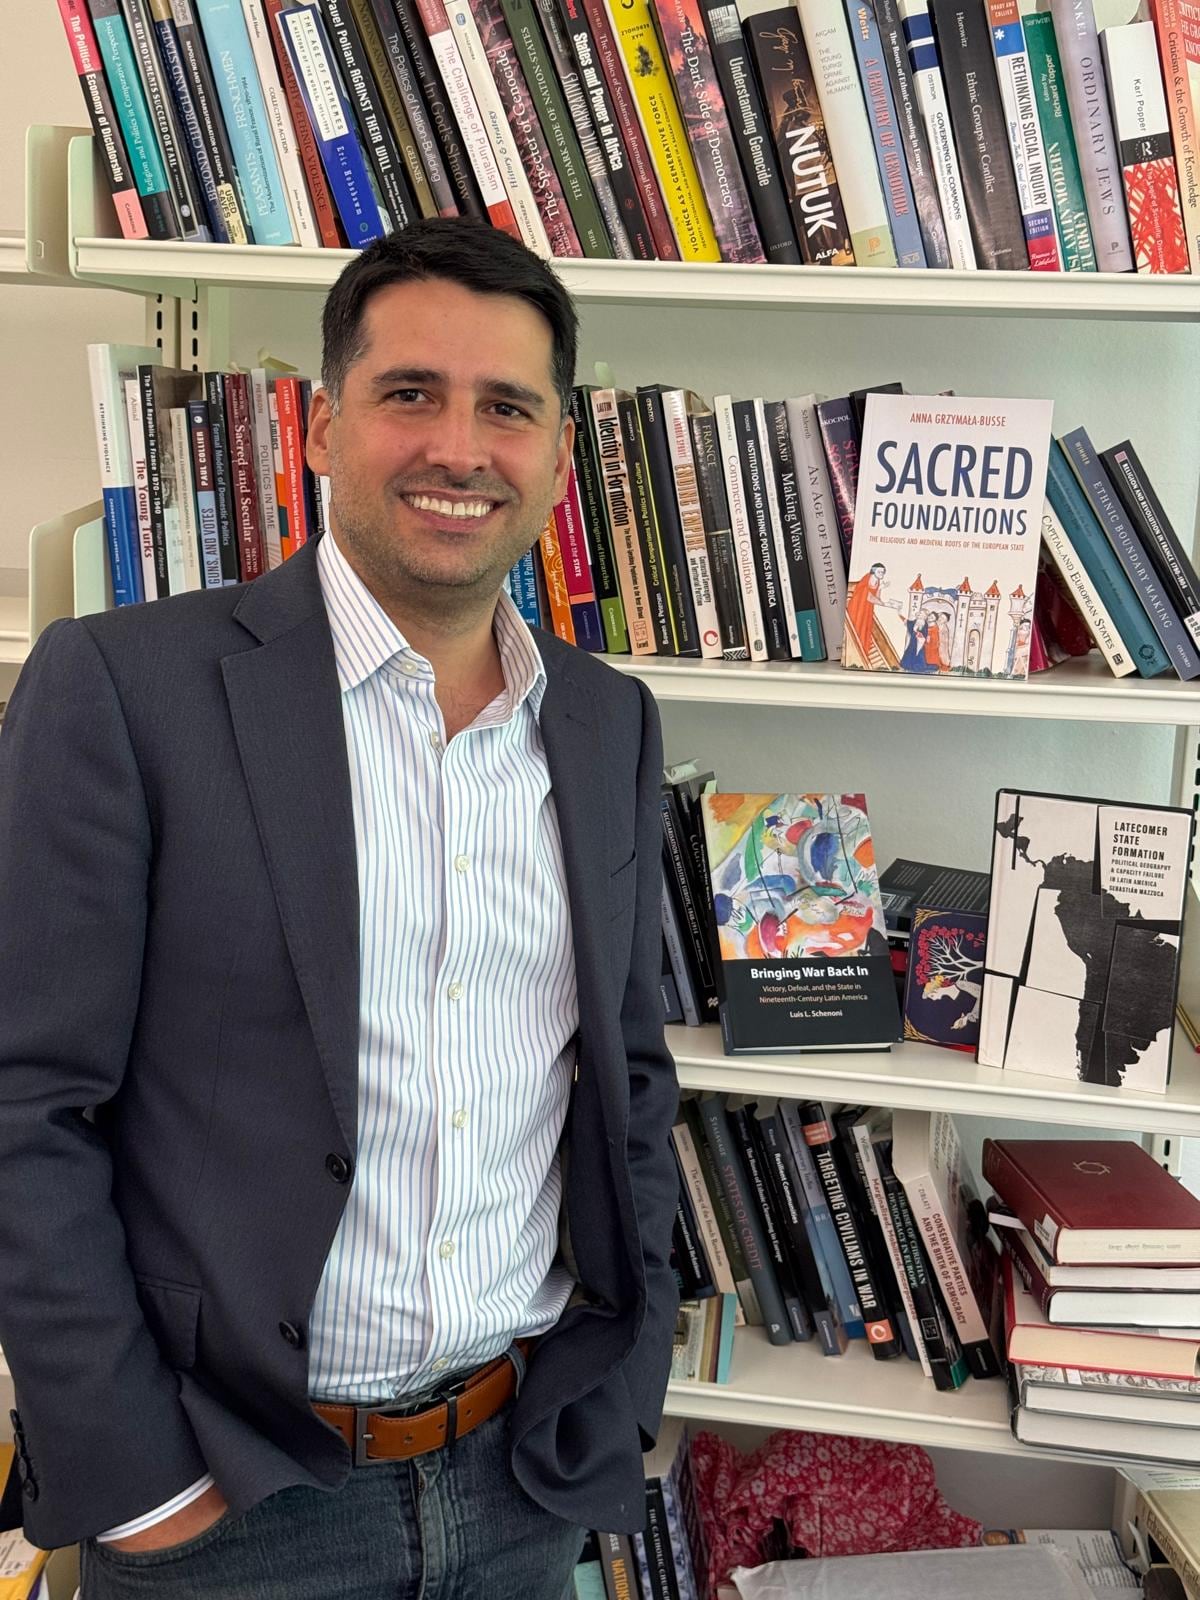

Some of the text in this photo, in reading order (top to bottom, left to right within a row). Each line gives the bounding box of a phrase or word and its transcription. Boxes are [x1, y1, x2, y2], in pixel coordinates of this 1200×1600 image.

[858, 8, 869, 40] Weitz
[70, 15, 123, 182] The Political Economy of Dictatorship
[162, 24, 218, 201] BEYOND CHURCH AND STATE
[388, 33, 441, 182] The Politics of Nation-Building
[444, 43, 498, 191] The Challenge of Pluralism
[521, 27, 582, 200] THE DARK SIDE OF NATION-STATES
[573, 32, 623, 171] States and Power in Africa
[729, 57, 772, 186] Understanding Genocide
[1134, 78, 1146, 131] Karl Popper
[493, 49, 560, 220] The Specter of Genocide
[966, 72, 995, 193] Ethnic Groups in Conflict
[1011, 56, 1047, 205] RETHINKING SOCIAL INQUIRY
[1081, 57, 1113, 215] ORDINARY JEWS
[785, 125, 837, 237] NUTUK
[816, 248, 840, 260] ALFA
[235, 425, 248, 465] Sacred
[598, 417, 621, 459] Identity
[775, 414, 788, 461] WEYLAND
[910, 413, 932, 424] ANNA
[196, 431, 208, 485] PAUL COLLIER
[605, 461, 624, 471] in
[703, 425, 717, 467] FRANCE
[875, 440, 1033, 500] SACRED
[1075, 441, 1090, 464] WIMMER
[238, 470, 250, 493] and
[260, 445, 274, 528] POLITICS IN TIME
[607, 473, 631, 526] Formation
[136, 460, 154, 557] The Young Turks
[241, 498, 254, 542] Secular
[728, 455, 753, 594] Commerce and Coalitions
[782, 472, 803, 561] Making Waves
[871, 502, 1028, 536] FOUNDATIONS
[201, 508, 220, 584] GUNS, AND VOTES
[880, 536, 906, 544] RELIGIOUS
[920, 539, 943, 547] MEDIEVAL
[944, 540, 962, 548] ROOTS
[1010, 544, 1025, 552] STATE
[1093, 481, 1172, 628] ETHNIC BOUNDARY MAKING
[1112, 846, 1165, 860] FORMATION
[1113, 834, 1140, 845] STATE
[1114, 822, 1168, 836] LATECOMER
[1112, 859, 1171, 871] POLITICAL GEOGRAPHY
[1116, 868, 1141, 876] CAPACITY
[1143, 871, 1164, 879] FAILURE
[1134, 879, 1157, 887] AMERICA
[1139, 889, 1164, 897] MAZZUCA
[751, 966, 868, 980] Bringing War Back In
[760, 995, 823, 1003] Nineteenth-Century
[762, 985, 786, 993] Victory,
[812, 1009, 843, 1017] Schenoni
[774, 1153, 798, 1223] Resilient Communities
[677, 1210, 701, 1278] International Relations
[724, 1165, 763, 1270] STATES OF CREDIT
[817, 1150, 877, 1308] TARGETING CIVILIANS IN WAR
[872, 1178, 917, 1321] Marginalized, Mobilized, Incorporated
[922, 1217, 966, 1324] AND THE BIRTH OF DEMOCRACY
[932, 1213, 967, 1296] CONSERVATIVE PARTIES
[649, 1509, 657, 1523] THE
[652, 1526, 664, 1566] CATHOLIC
